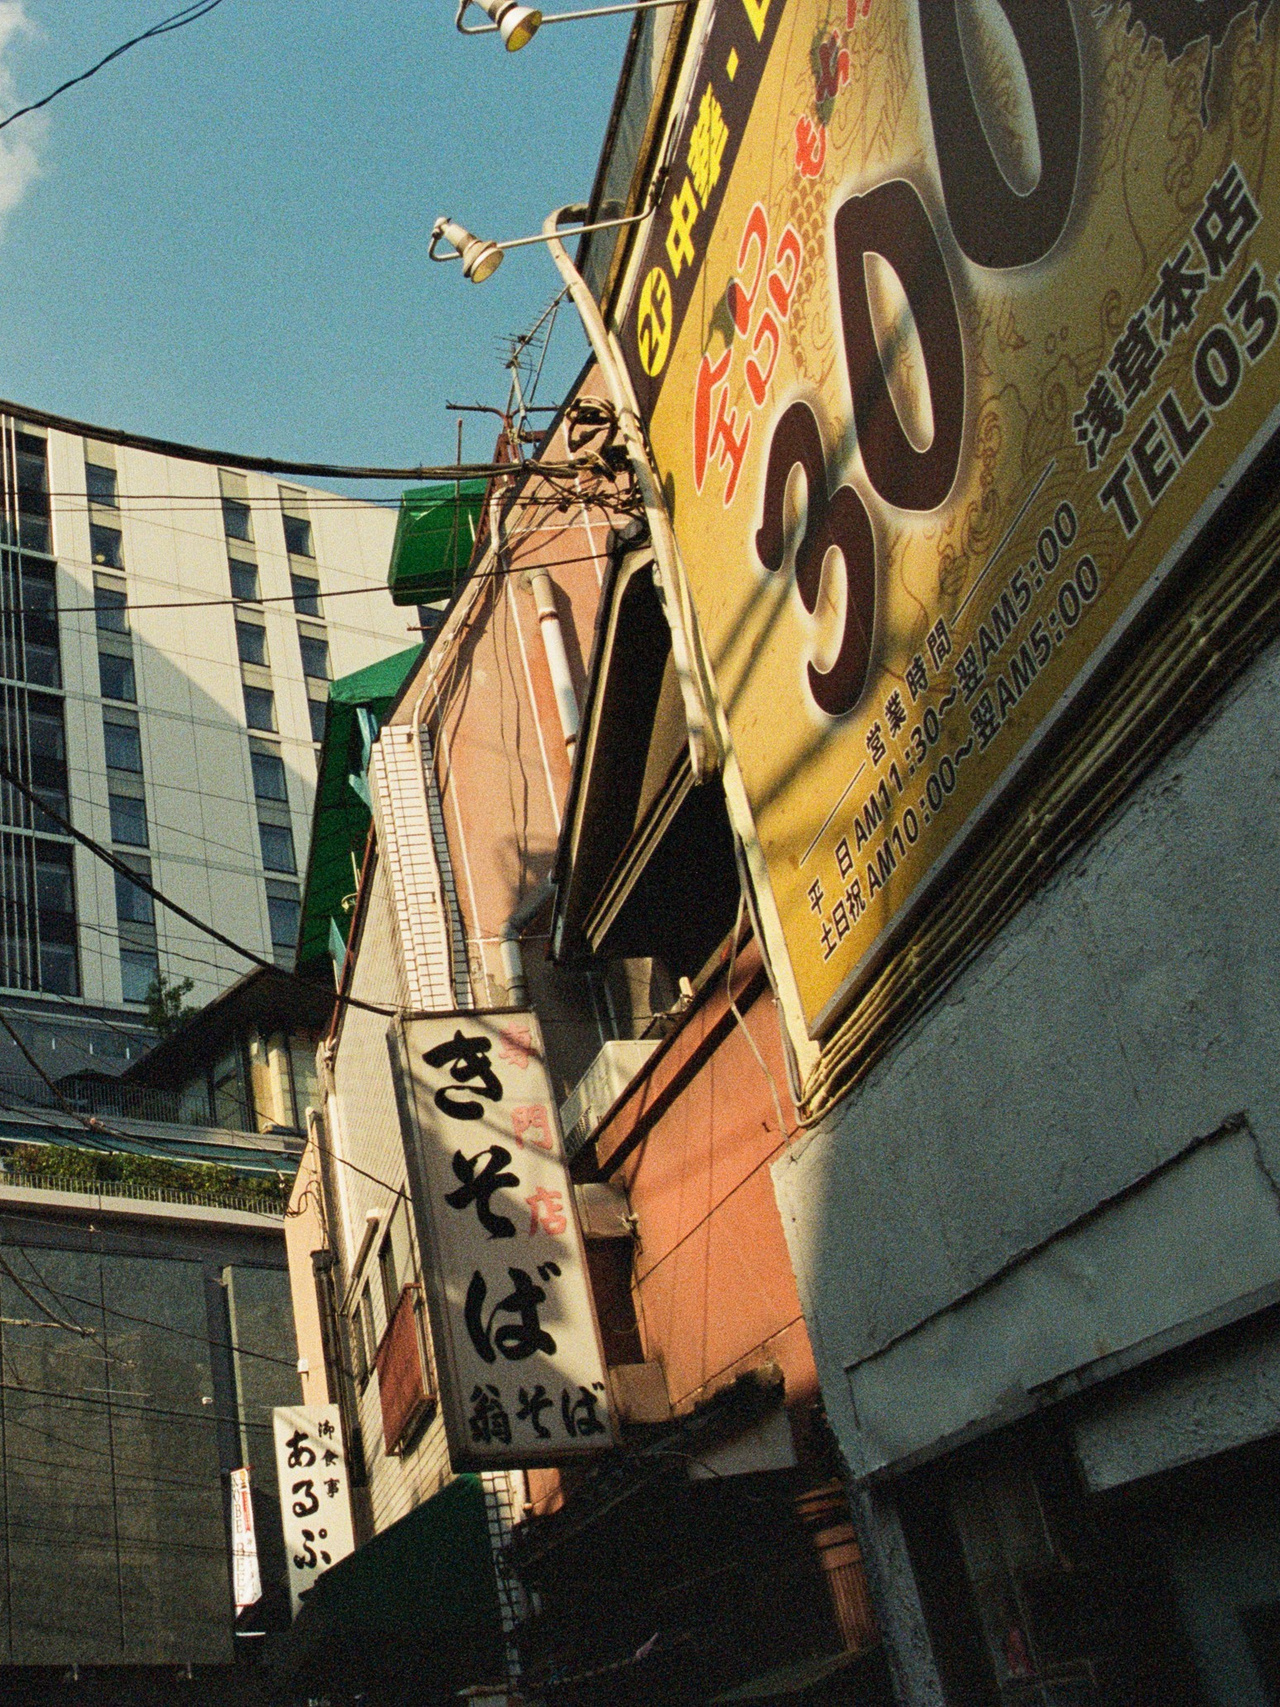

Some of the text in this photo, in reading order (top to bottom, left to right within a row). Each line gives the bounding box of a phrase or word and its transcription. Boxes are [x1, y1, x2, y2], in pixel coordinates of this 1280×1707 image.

[665, 0, 770, 278] 中華・
[1073, 161, 1263, 470] 浅草本店
[865, 614, 954, 768] 営業時間
[422, 1029, 562, 1364] きそば
[498, 1020, 567, 1238] 専門店
[318, 1418, 341, 1498] 御食事
[469, 1381, 606, 1445] 翁そば
